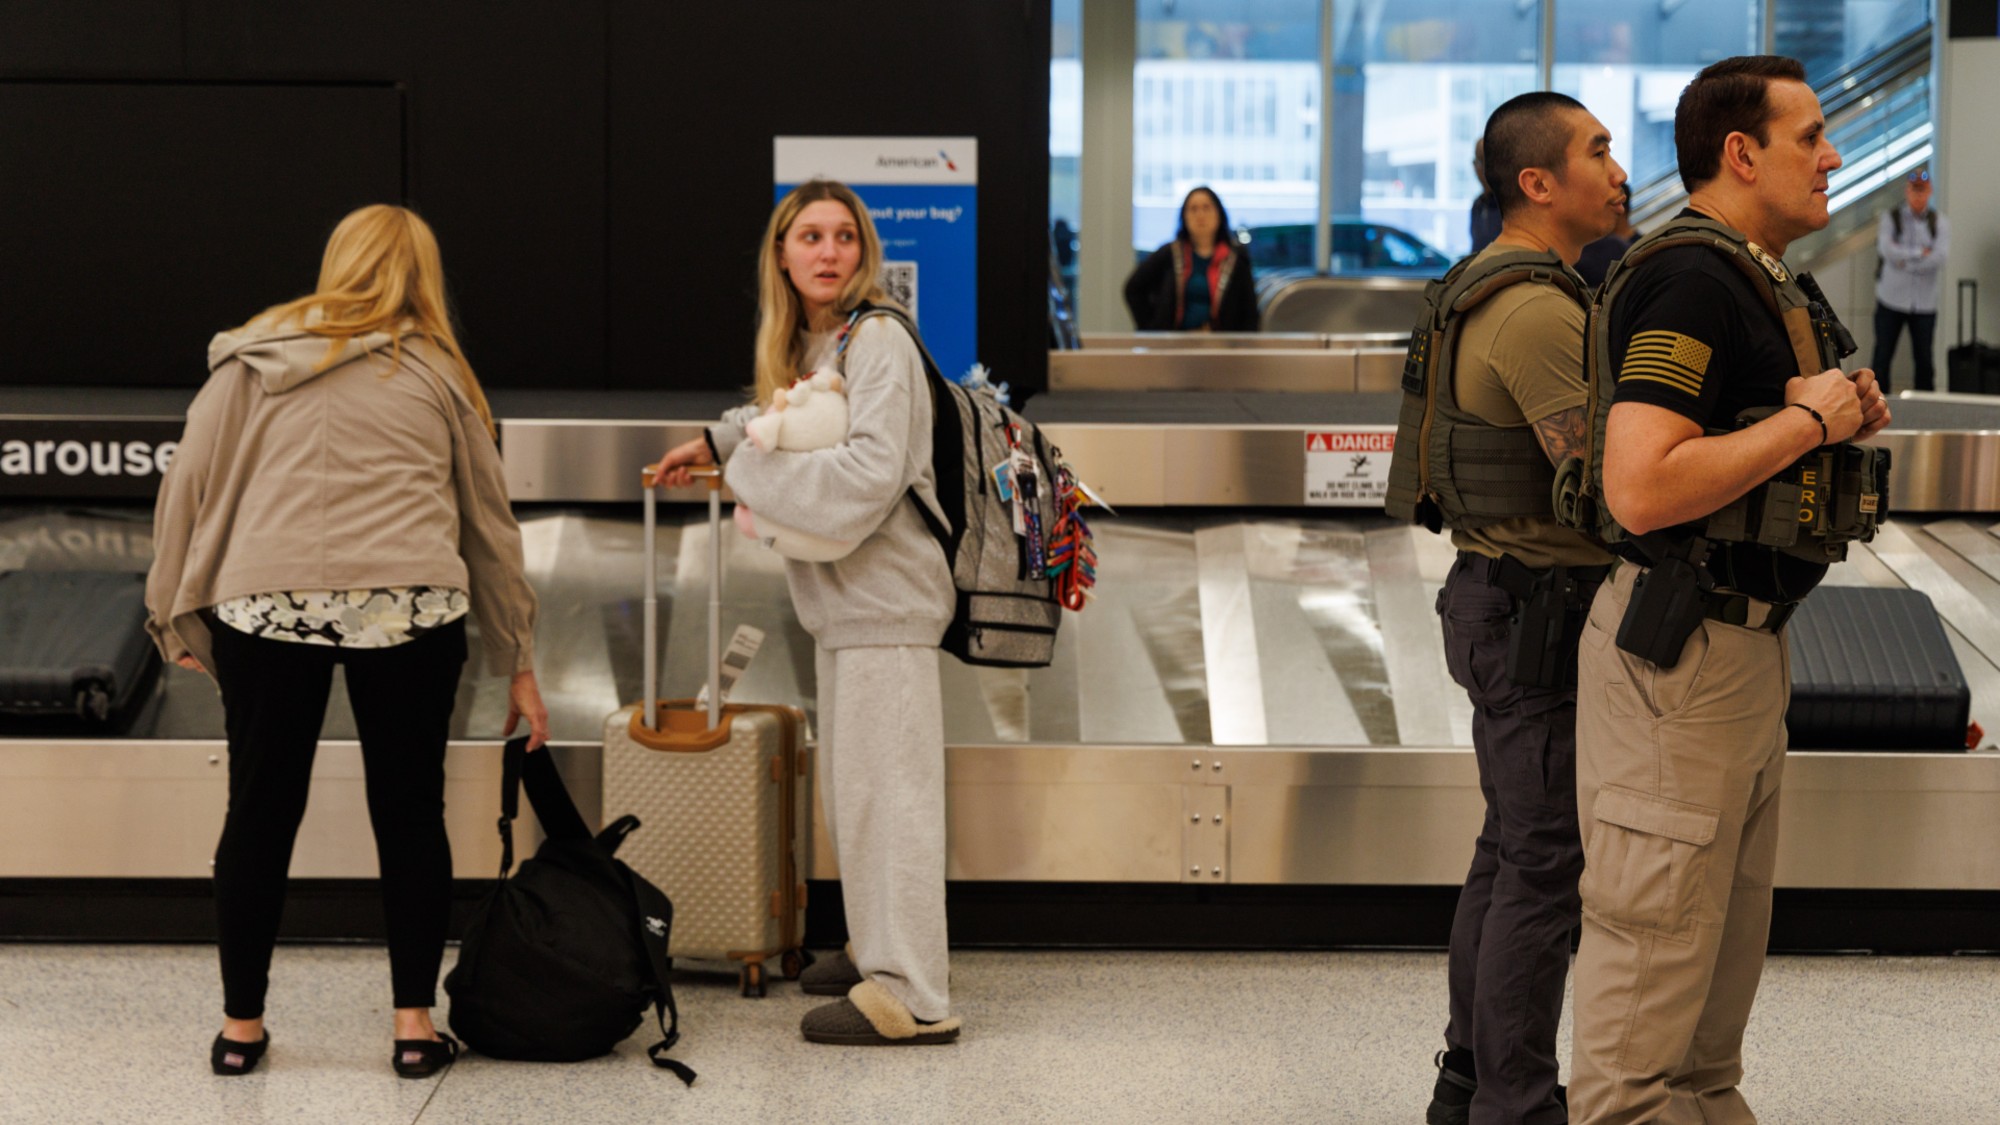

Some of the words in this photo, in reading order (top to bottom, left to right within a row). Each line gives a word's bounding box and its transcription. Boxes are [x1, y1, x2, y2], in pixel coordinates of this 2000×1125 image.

[877, 155, 938, 168] American
[869, 207, 894, 220] out
[896, 208, 927, 223] your
[929, 205, 963, 223] bag?
[1331, 433, 1396, 450] DANGE
[0, 440, 182, 476] arouse
